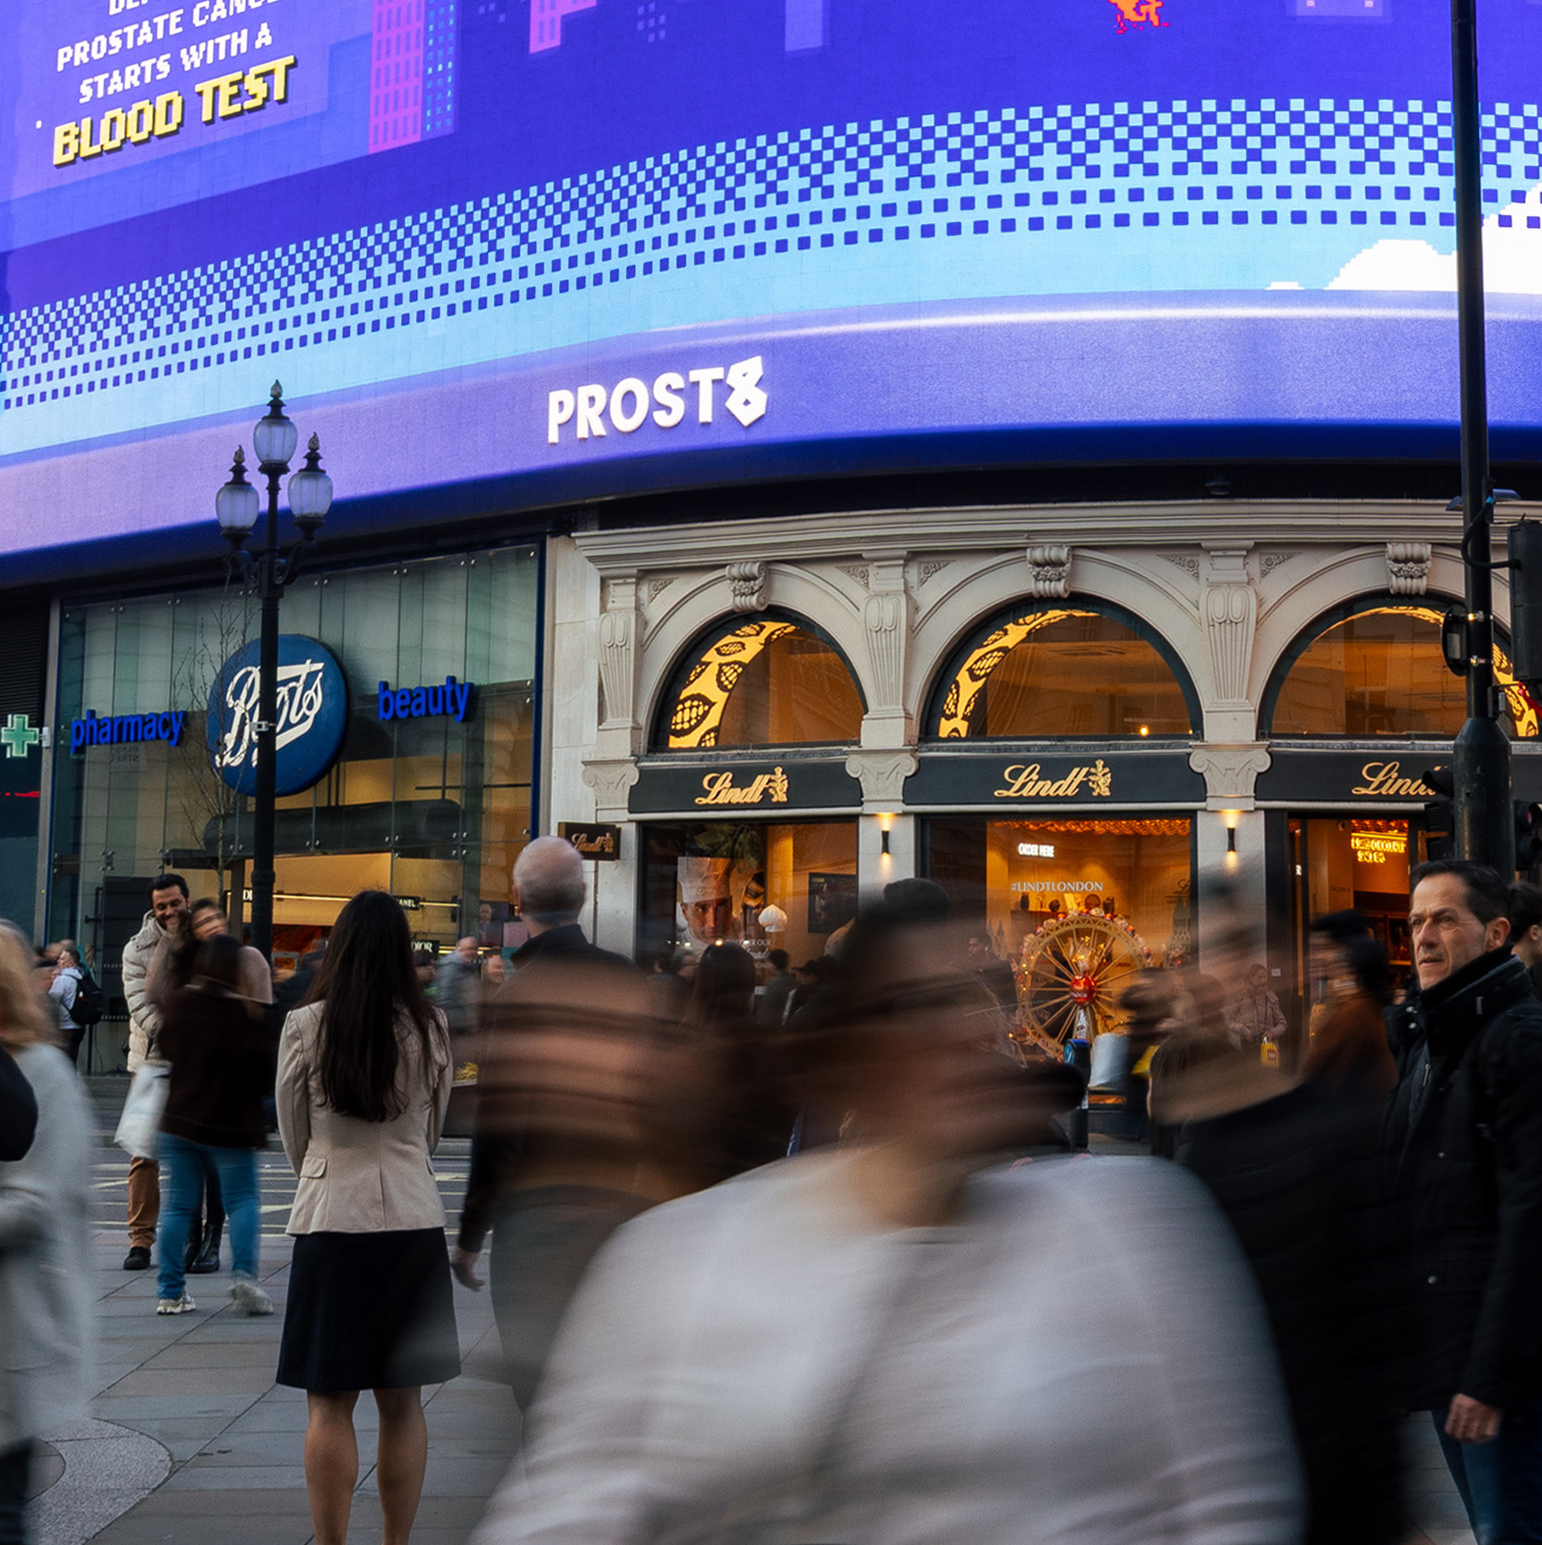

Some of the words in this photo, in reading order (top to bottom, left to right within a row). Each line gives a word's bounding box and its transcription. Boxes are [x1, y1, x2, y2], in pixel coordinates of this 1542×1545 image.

[58, 9, 184, 71] PROSTATE
[79, 54, 171, 103] STARTS
[180, 28, 248, 71] WITH
[255, 22, 272, 50] A
[53, 91, 183, 166] BLOOD
[195, 55, 296, 123] TEST
[215, 659, 324, 767] Bots
[378, 676, 472, 723] beauty
[70, 709, 184, 755] pharmacy
[694, 771, 772, 805] Lindt
[994, 763, 1090, 797] Lindt
[1011, 881, 1103, 893] #LINDTLONDON
